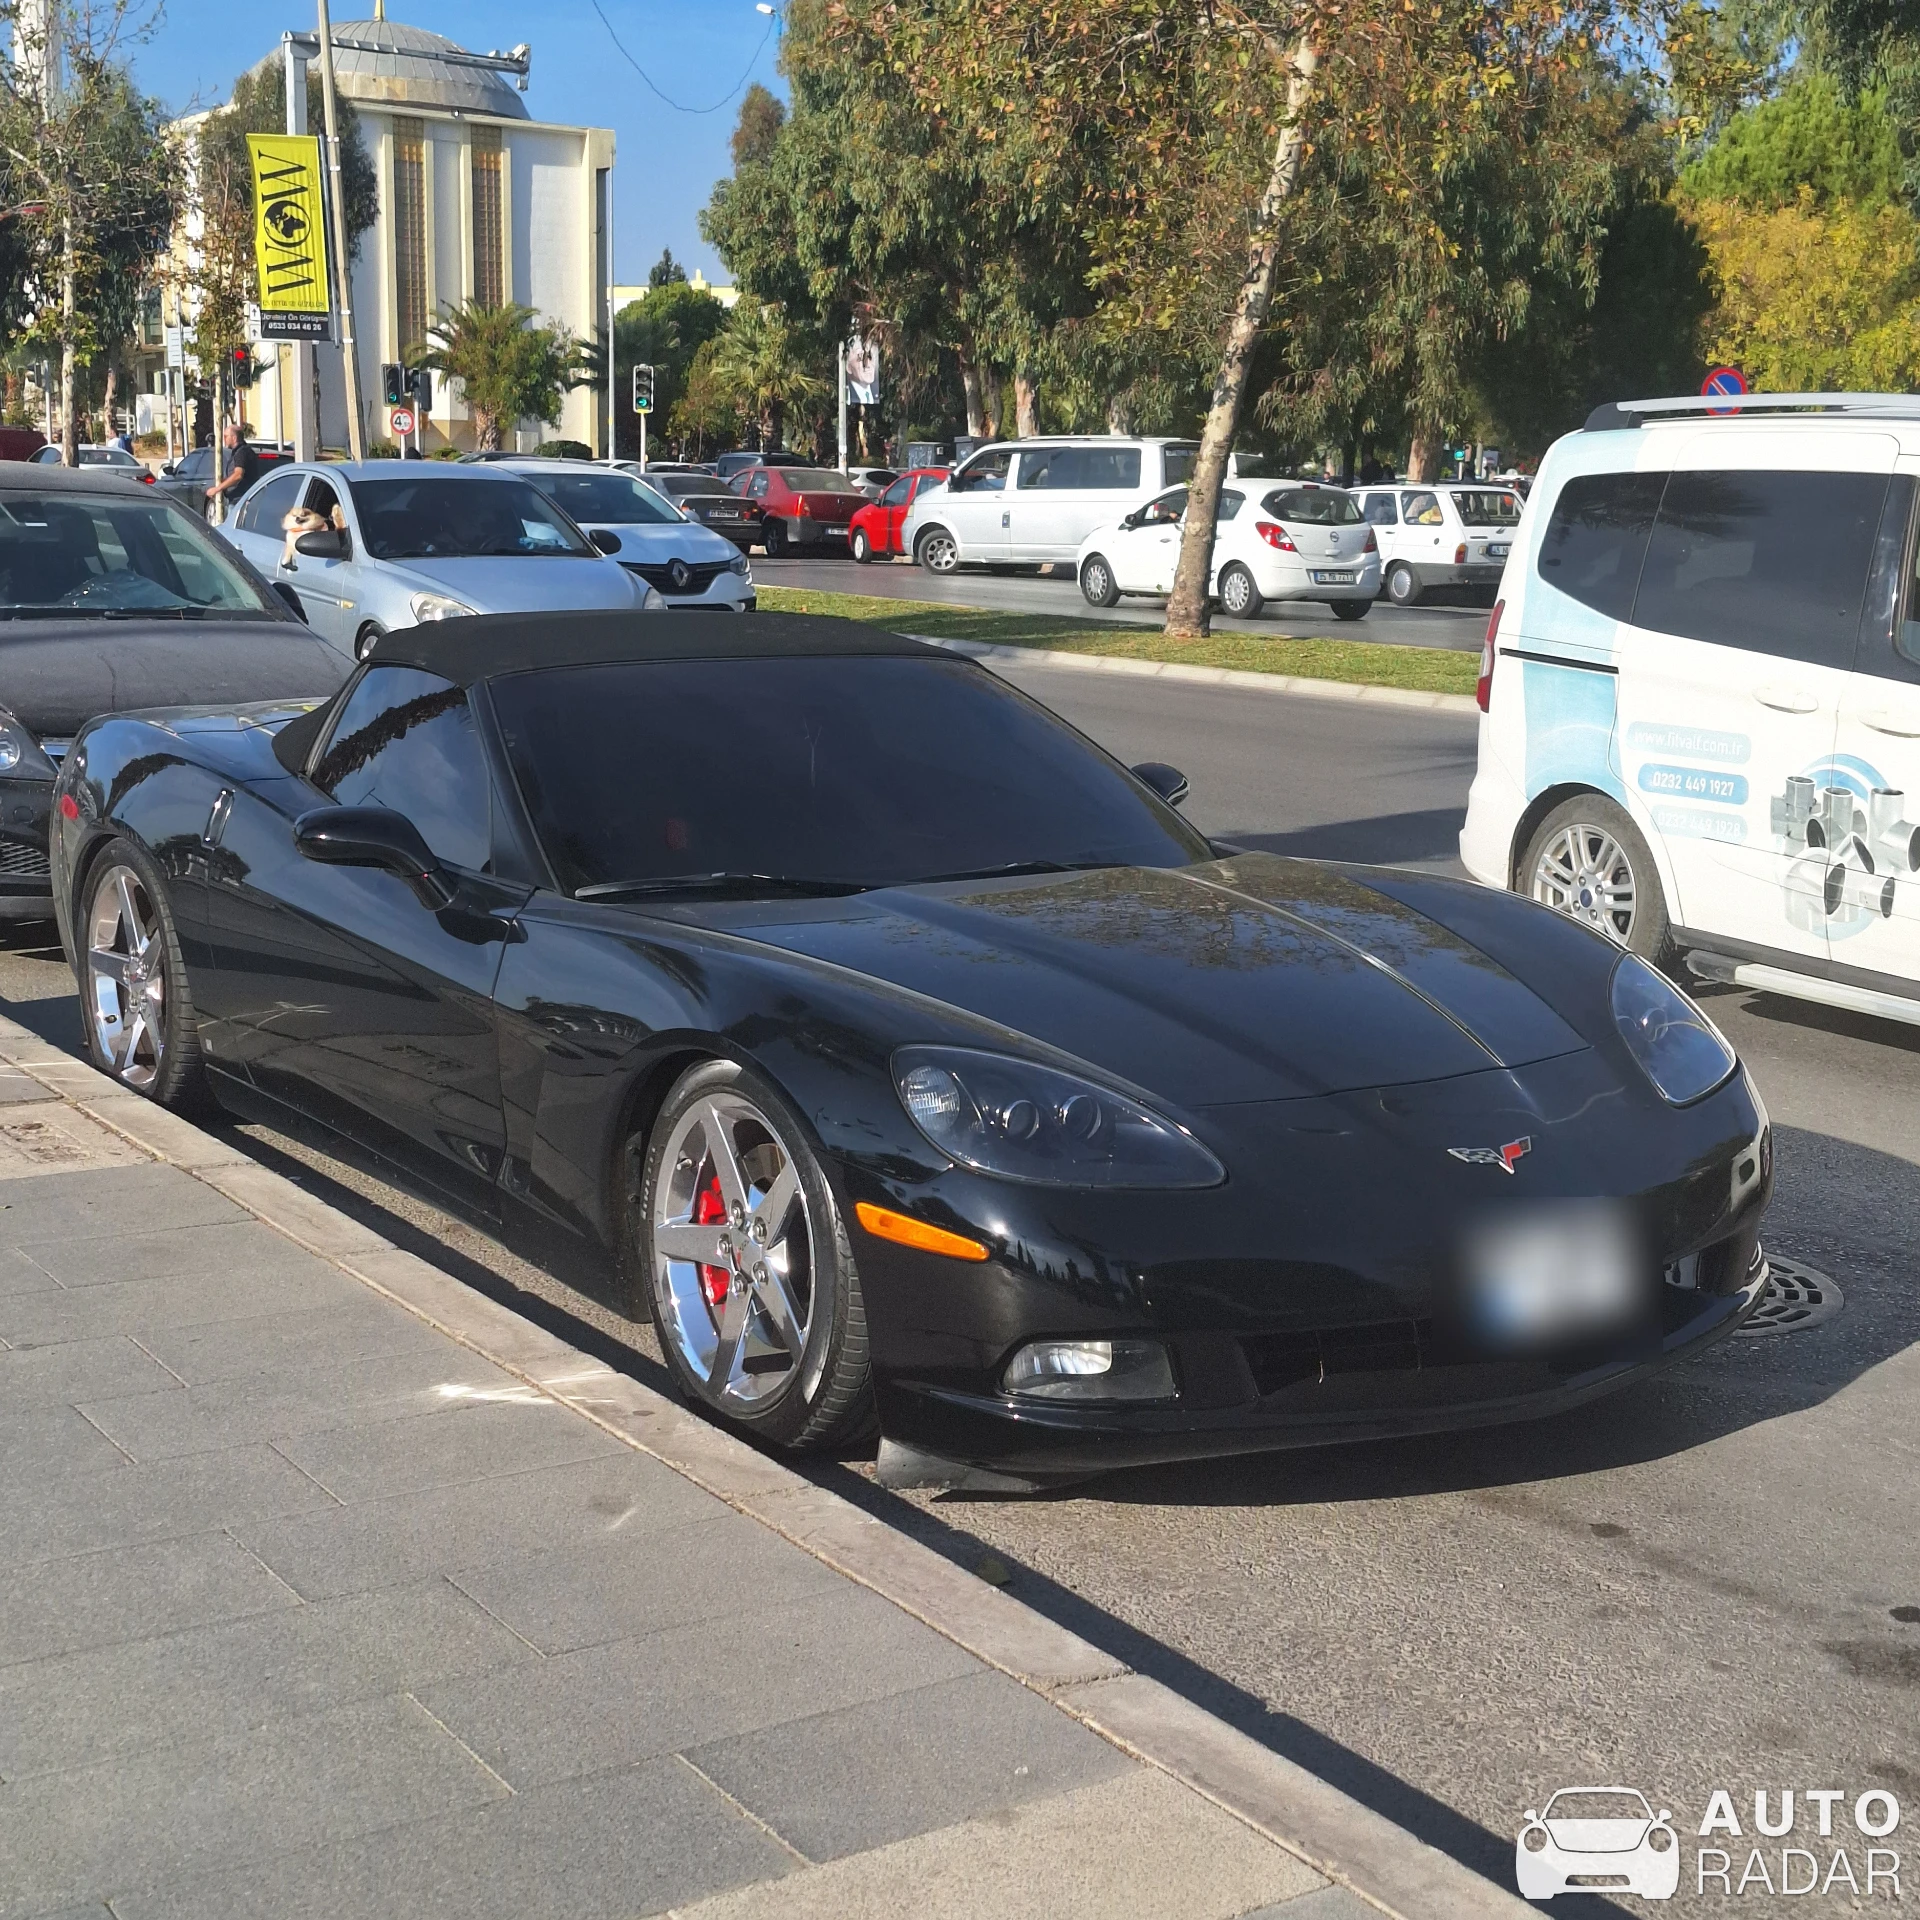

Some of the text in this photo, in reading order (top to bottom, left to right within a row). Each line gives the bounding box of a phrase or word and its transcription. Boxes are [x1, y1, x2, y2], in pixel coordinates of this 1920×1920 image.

[257, 148, 315, 297] WOW
[1652, 770, 1735, 797] 0232 449 1927
[1715, 819, 1741, 837] 1928
